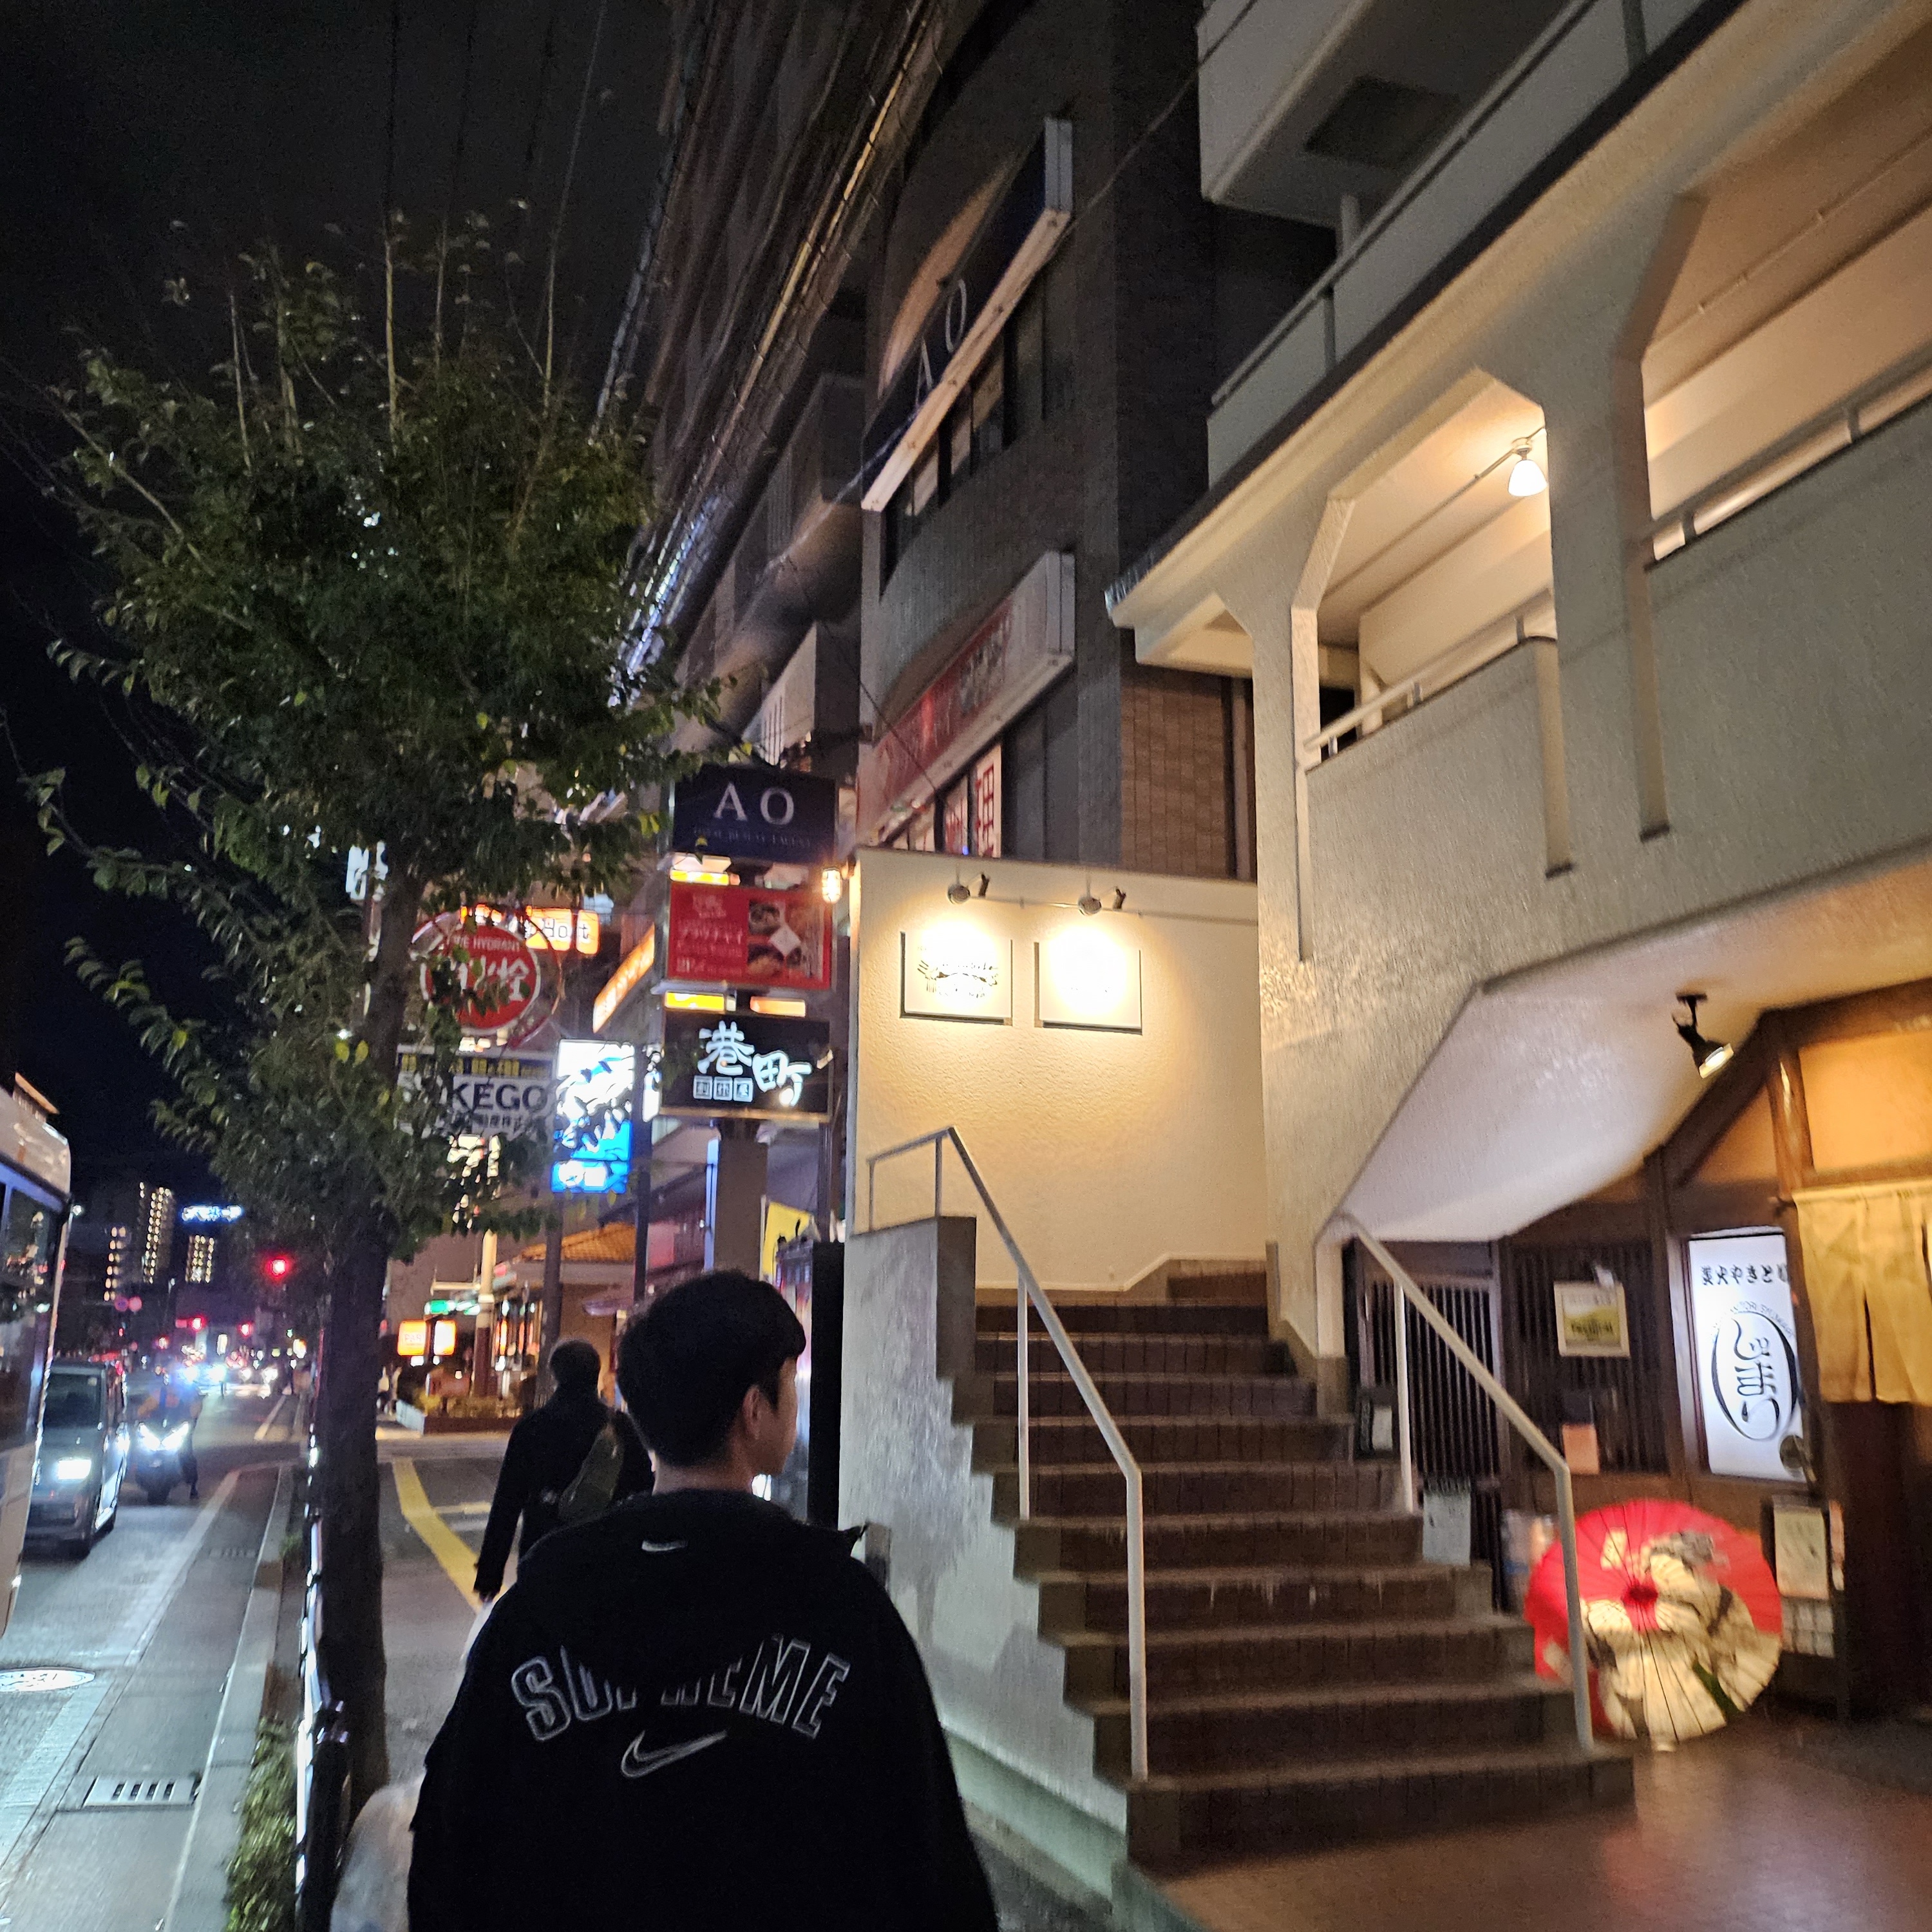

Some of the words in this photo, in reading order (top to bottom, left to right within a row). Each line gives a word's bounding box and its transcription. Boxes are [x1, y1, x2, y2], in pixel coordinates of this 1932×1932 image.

[712, 781, 795, 826] AO
[433, 955, 529, 1001] 火栓
[697, 1020, 813, 1106] 港町
[511, 1633, 851, 1741] SUME
